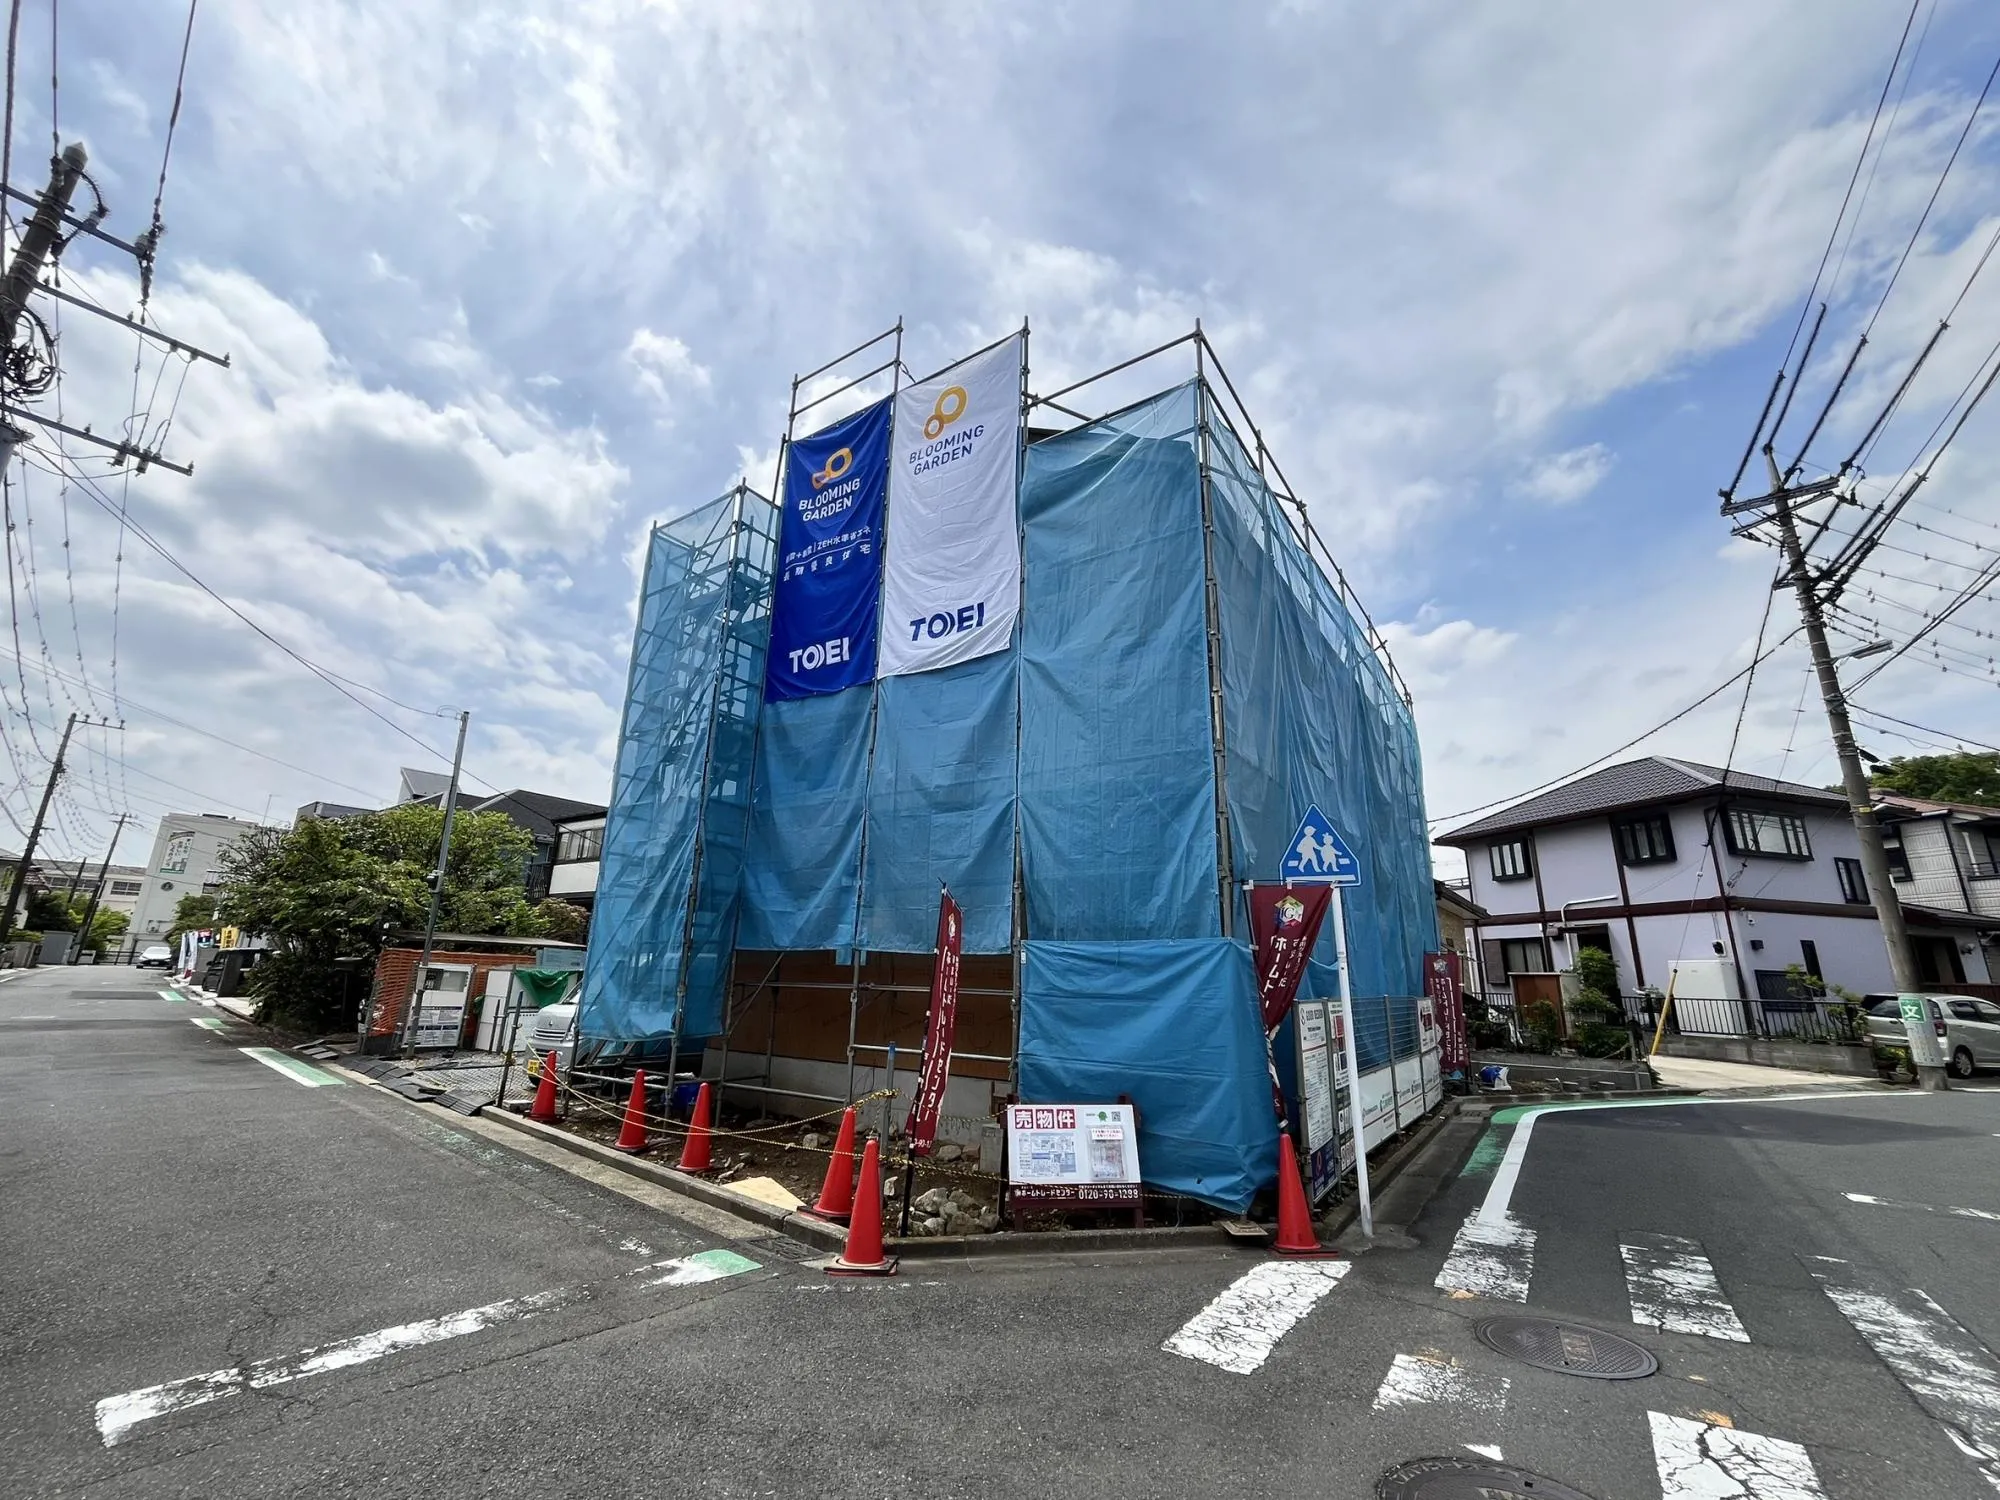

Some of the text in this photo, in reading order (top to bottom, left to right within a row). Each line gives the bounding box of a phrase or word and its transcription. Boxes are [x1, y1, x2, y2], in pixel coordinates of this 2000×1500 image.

[909, 424, 985, 464] BLOOMING
[913, 443, 974, 475] GARDEN
[798, 478, 861, 511] BLOOMING
[802, 495, 853, 522] GARDEN
[909, 601, 985, 642] TOEI
[788, 636, 850, 674] TOEI
[1015, 1108, 1076, 1129] 売物件
